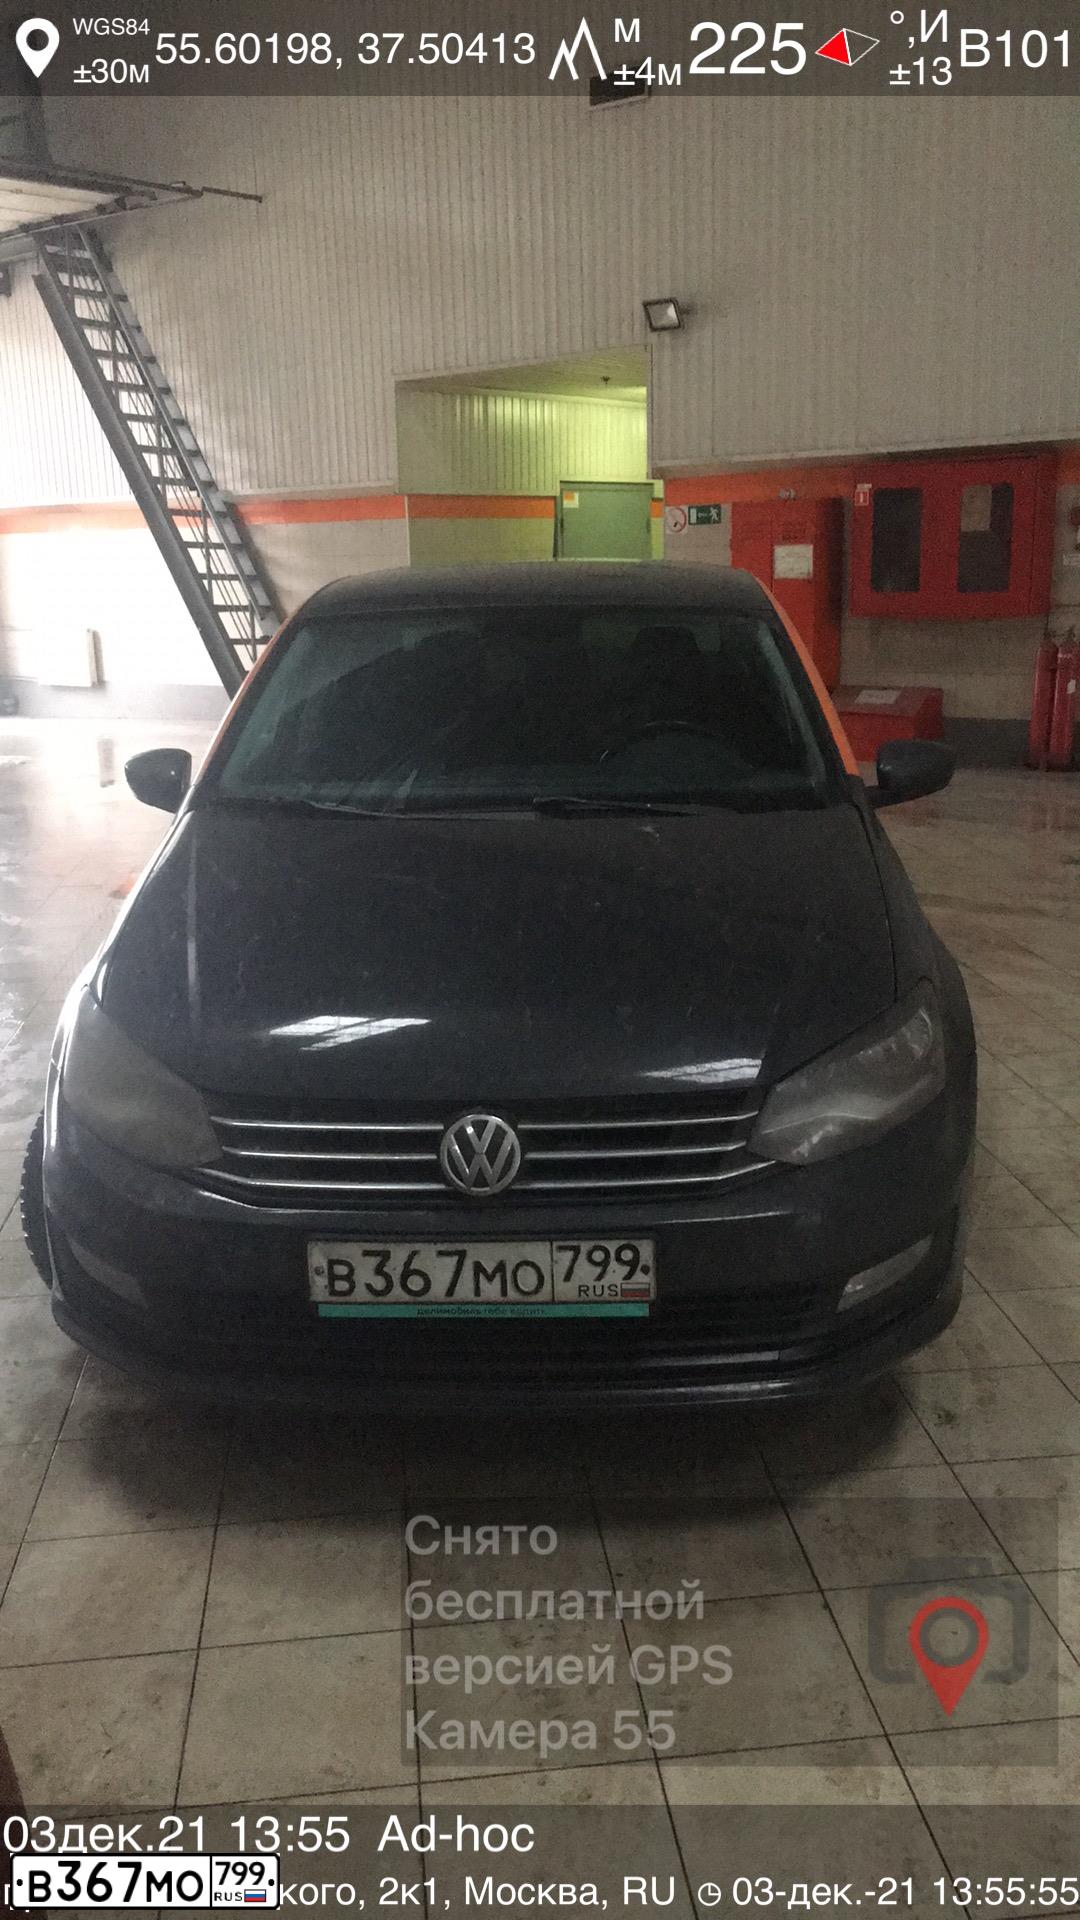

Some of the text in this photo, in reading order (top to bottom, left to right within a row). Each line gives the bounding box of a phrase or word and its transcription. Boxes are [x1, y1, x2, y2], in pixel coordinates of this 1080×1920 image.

[326, 1243, 641, 1298] В367МО 799
[577, 1283, 619, 1298] RUS
